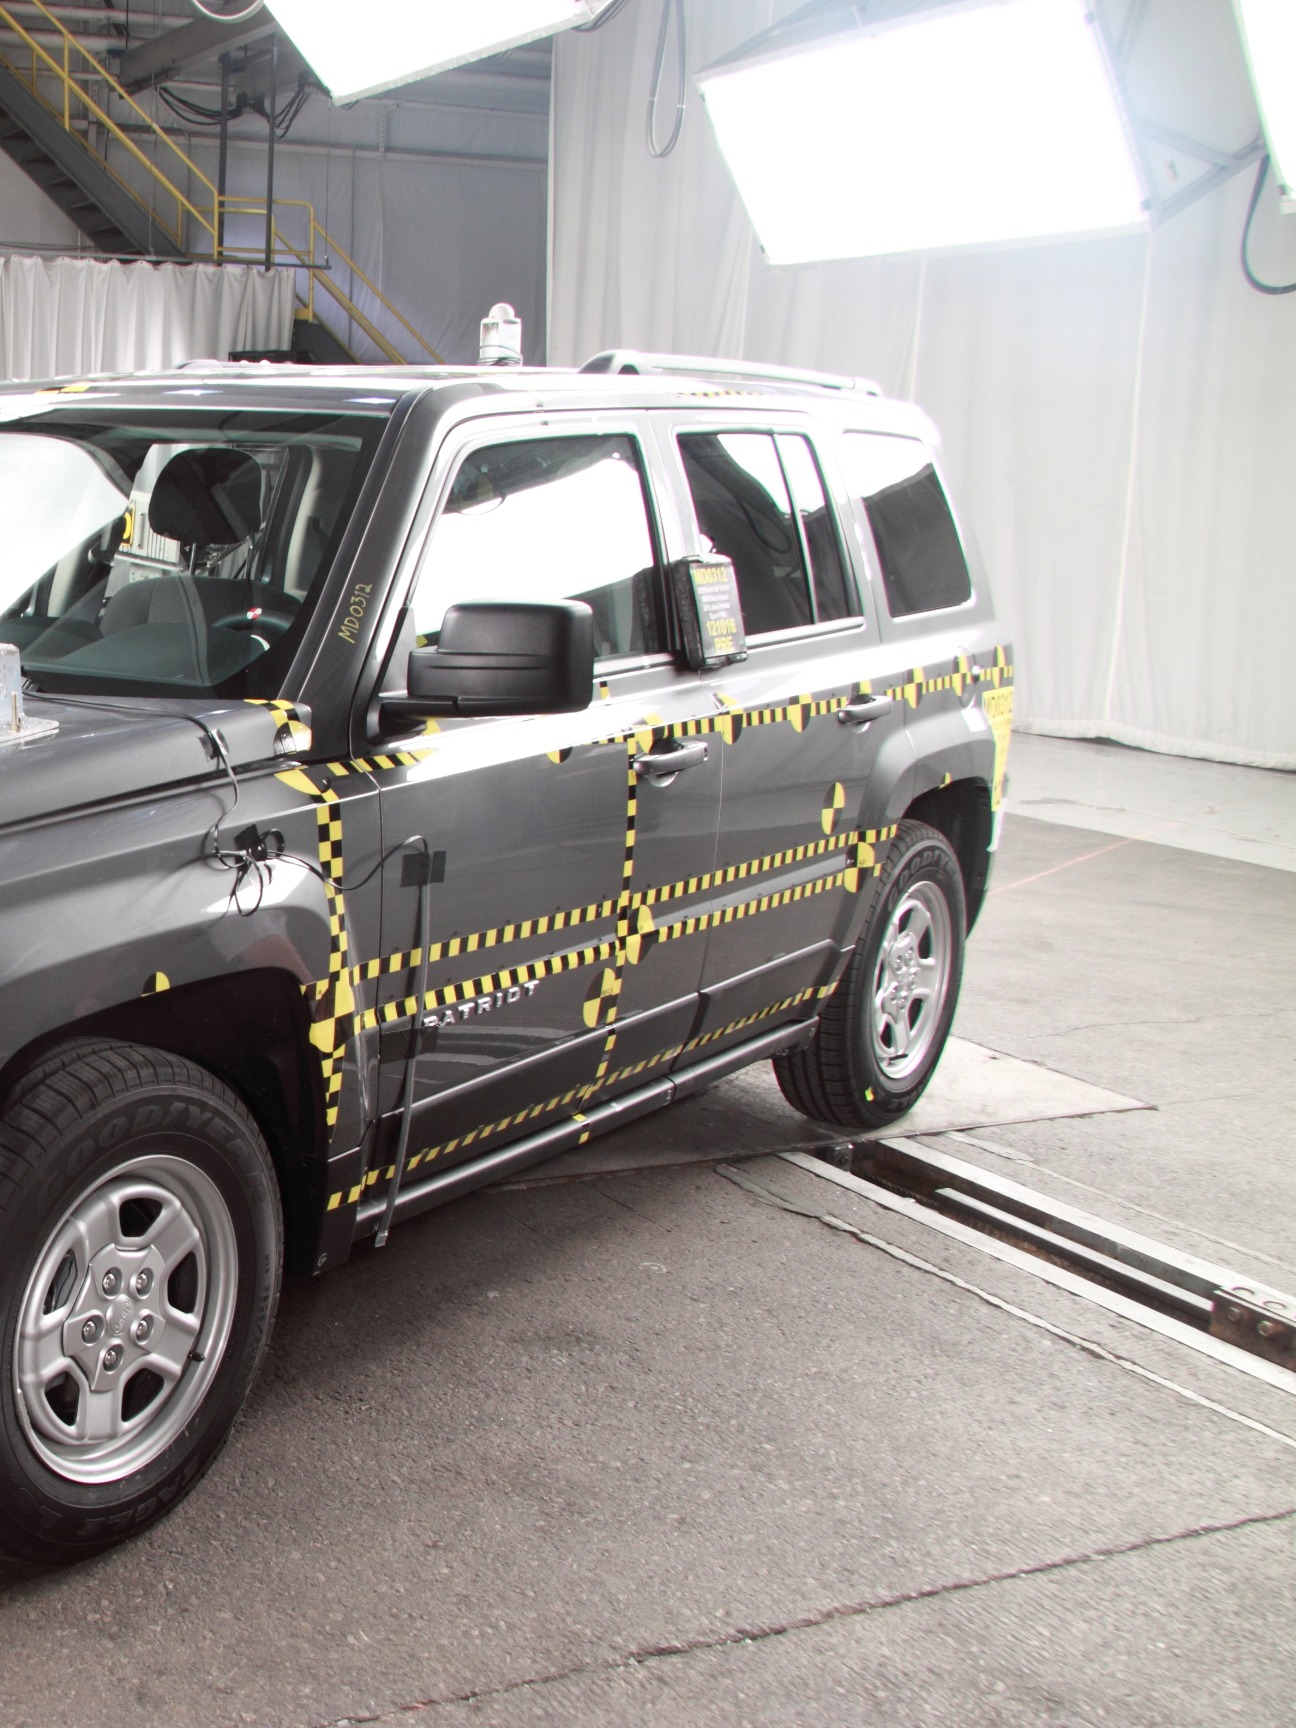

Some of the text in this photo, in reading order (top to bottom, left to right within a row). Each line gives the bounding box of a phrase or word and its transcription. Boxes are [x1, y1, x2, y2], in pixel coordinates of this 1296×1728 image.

[694, 566, 728, 585] MD0312
[337, 583, 373, 644] MD0312
[706, 617, 737, 637] 121016
[714, 635, 735, 652] PRE
[422, 979, 540, 1028] PATRIOT
